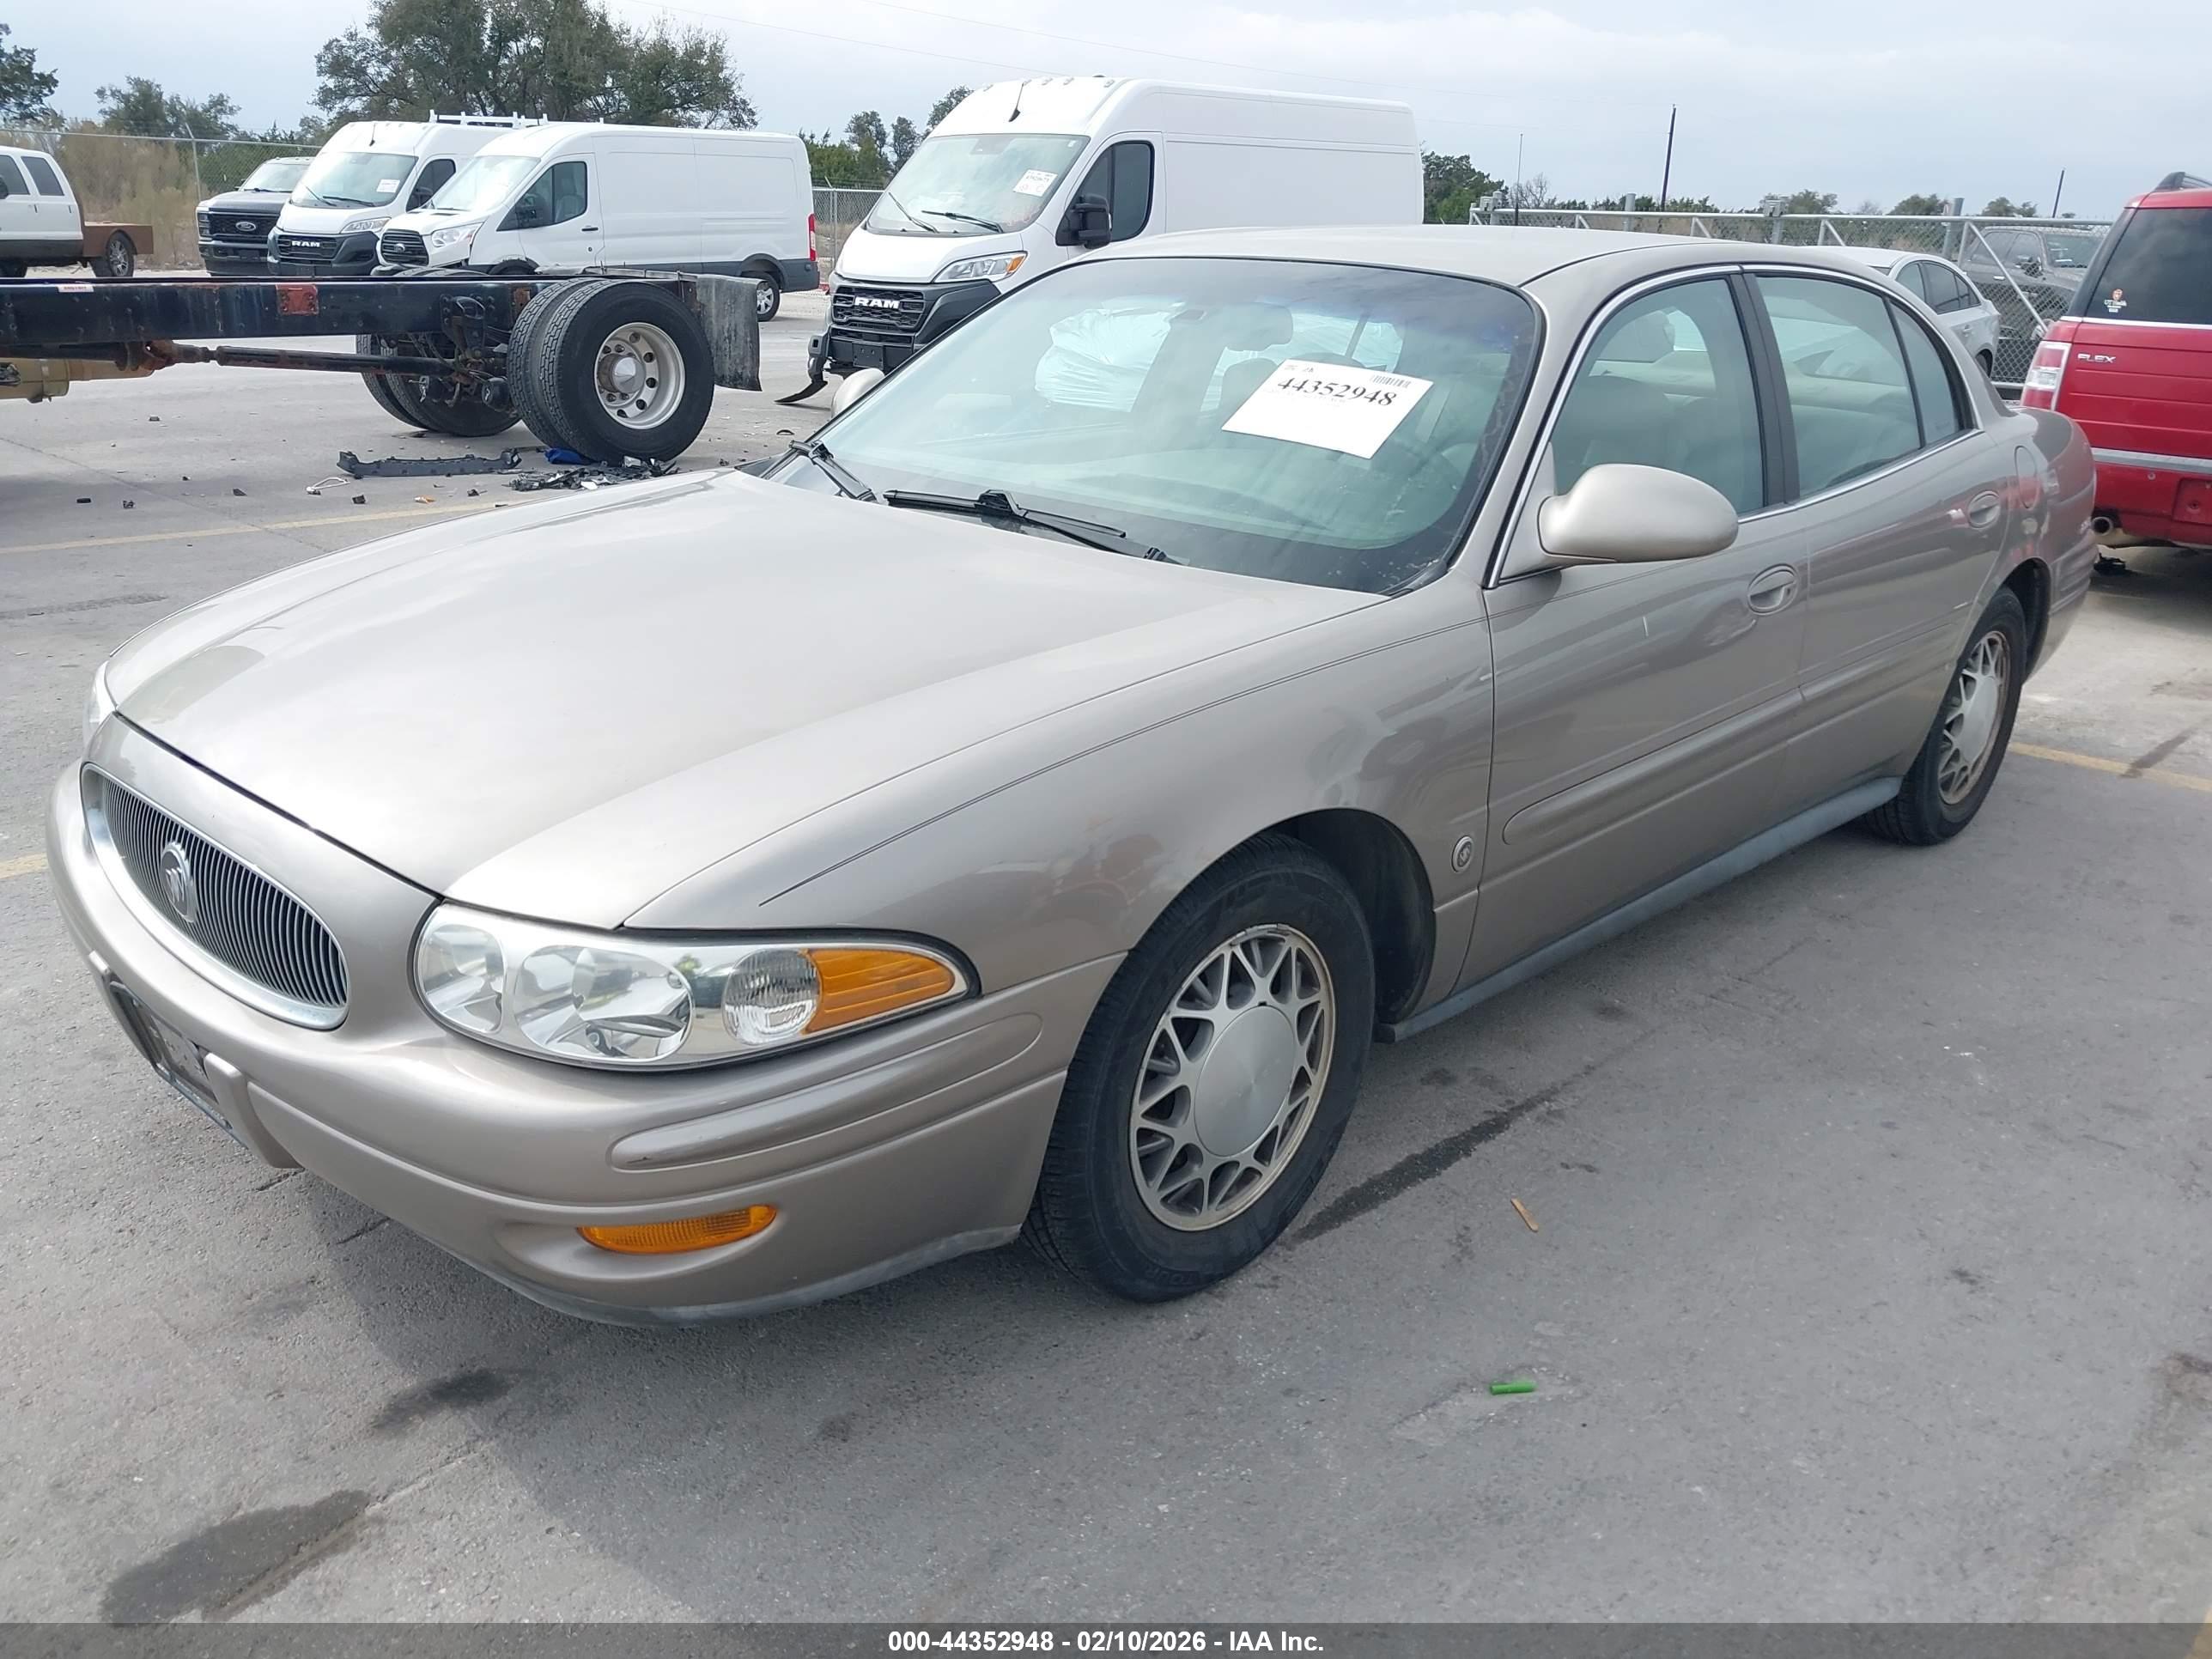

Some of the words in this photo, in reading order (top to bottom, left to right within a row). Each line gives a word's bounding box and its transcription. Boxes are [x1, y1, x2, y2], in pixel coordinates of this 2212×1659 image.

[854, 296, 900, 309] RAM
[2077, 353, 2117, 363] FLEX
[1277, 377, 1398, 407] 44352948
